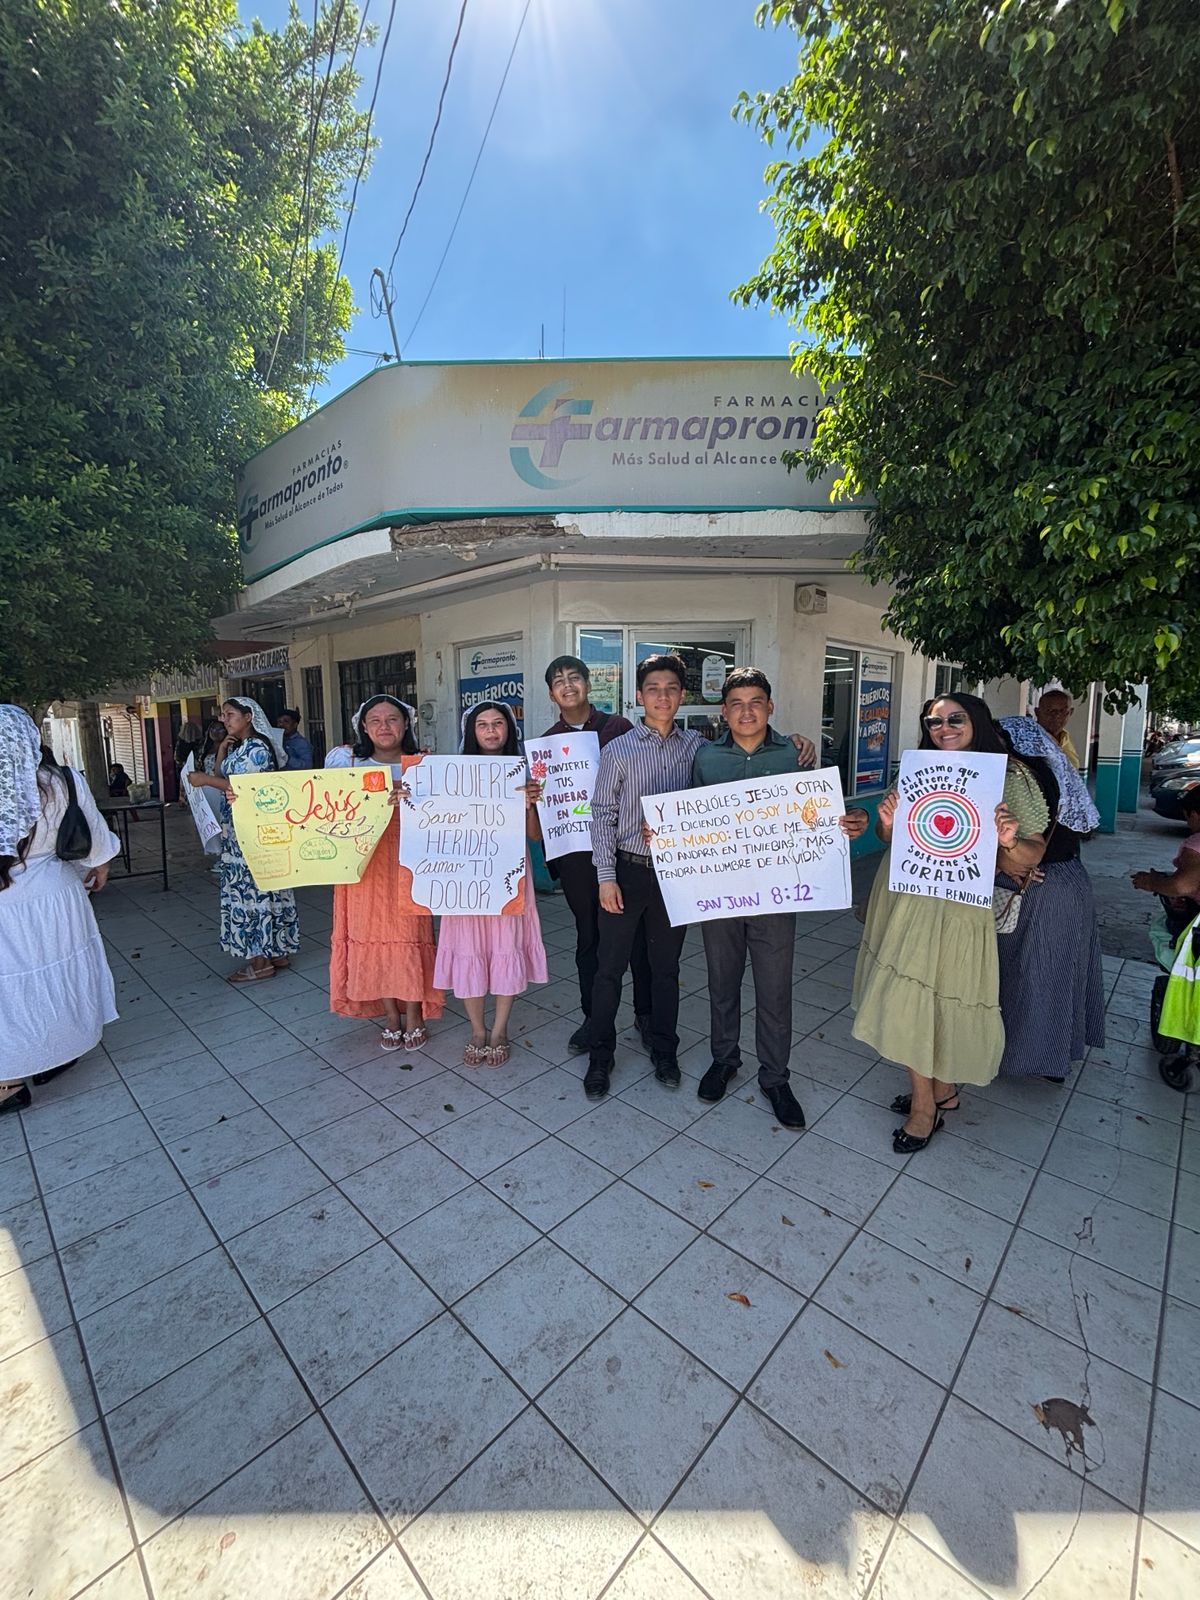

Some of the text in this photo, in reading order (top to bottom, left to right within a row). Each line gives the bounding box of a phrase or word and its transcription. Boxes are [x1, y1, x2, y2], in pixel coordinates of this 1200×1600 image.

[714, 395, 837, 408] FARMACIA
[292, 440, 342, 476] FARMACIAS
[612, 451, 777, 466] Más Salud al Alcance
[294, 497, 316, 512] Alcance
[325, 482, 343, 497] Todos
[531, 749, 552, 762] DIOS
[548, 760, 590, 775] CONVIERTE
[415, 762, 516, 800] EL QUIERE
[554, 777, 574, 789] TUS
[902, 775, 968, 795] sostiene el
[958, 766, 980, 779] que
[285, 779, 361, 825] Jesús
[546, 790, 588, 808] PRUEBAS
[654, 802, 665, 822] Y
[745, 784, 788, 804] JESÚS
[795, 779, 833, 796] OTRA
[418, 800, 506, 830] Sanar TUS
[556, 808, 569, 820] EN
[651, 824, 677, 837] VEZ
[680, 814, 731, 832] DICIENDO
[735, 809, 755, 825] YO
[757, 804, 780, 820] SOY
[786, 800, 802, 815] LA
[426, 829, 499, 857] HERIDAS
[656, 836, 678, 850] DEL
[683, 830, 732, 847] MUNDO:
[735, 826, 751, 840] EL
[753, 823, 778, 838] QUE
[784, 821, 802, 834] ME
[656, 851, 673, 865] NO
[677, 847, 718, 861] ANDARA
[721, 843, 737, 855] EN
[963, 852, 978, 864] tu
[657, 866, 697, 881] TENDRA
[700, 863, 713, 875] LA
[714, 858, 751, 874] LUMBRE
[757, 857, 772, 869] DE
[777, 855, 790, 866] LA
[901, 859, 981, 883] CORAZÓN
[429, 879, 491, 910] DOLOR
[696, 883, 814, 912] SAN JUAN 8:12
[892, 882, 992, 908] ¡DIOS TE BENDIGA!
